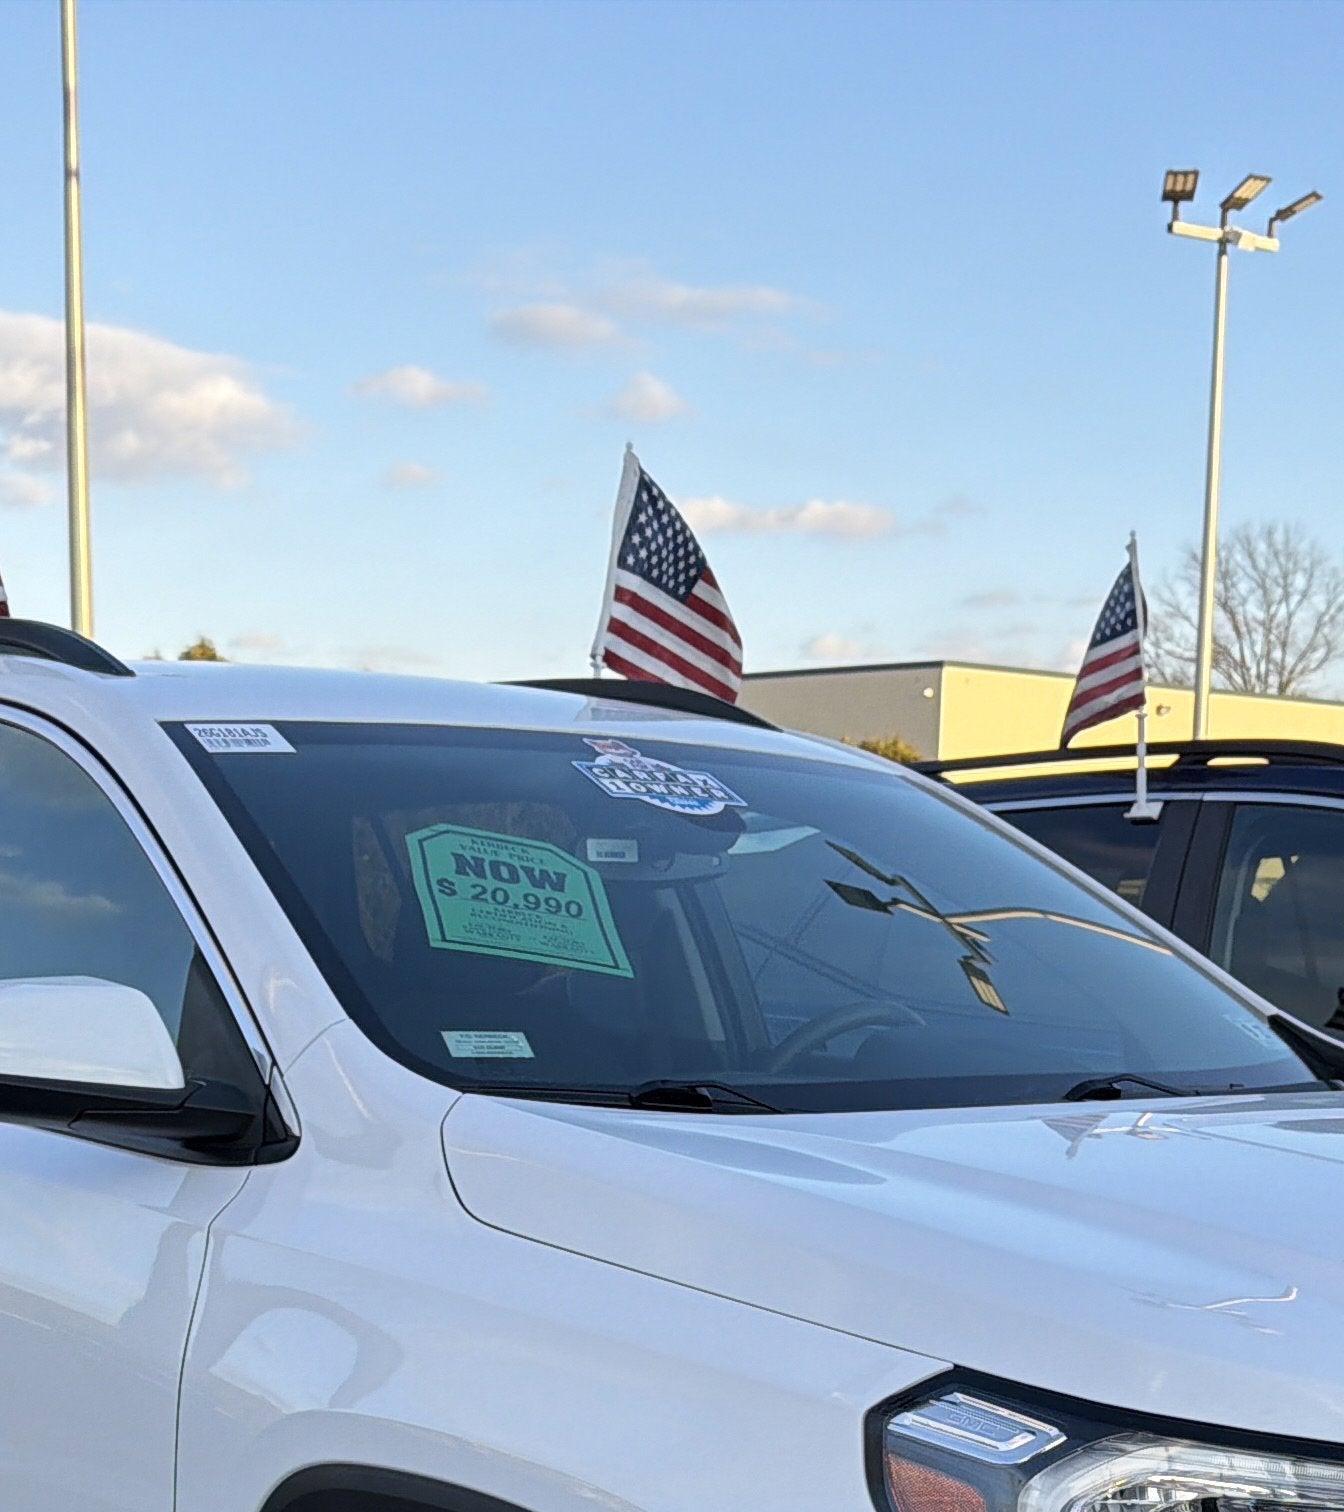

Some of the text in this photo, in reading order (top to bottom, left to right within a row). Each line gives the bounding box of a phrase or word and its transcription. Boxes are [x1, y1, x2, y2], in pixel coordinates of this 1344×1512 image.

[592, 767, 718, 789] CARFAX
[629, 782, 728, 800] OWNER
[452, 851, 568, 893] NOW
[435, 877, 584, 919] $ 20,990
